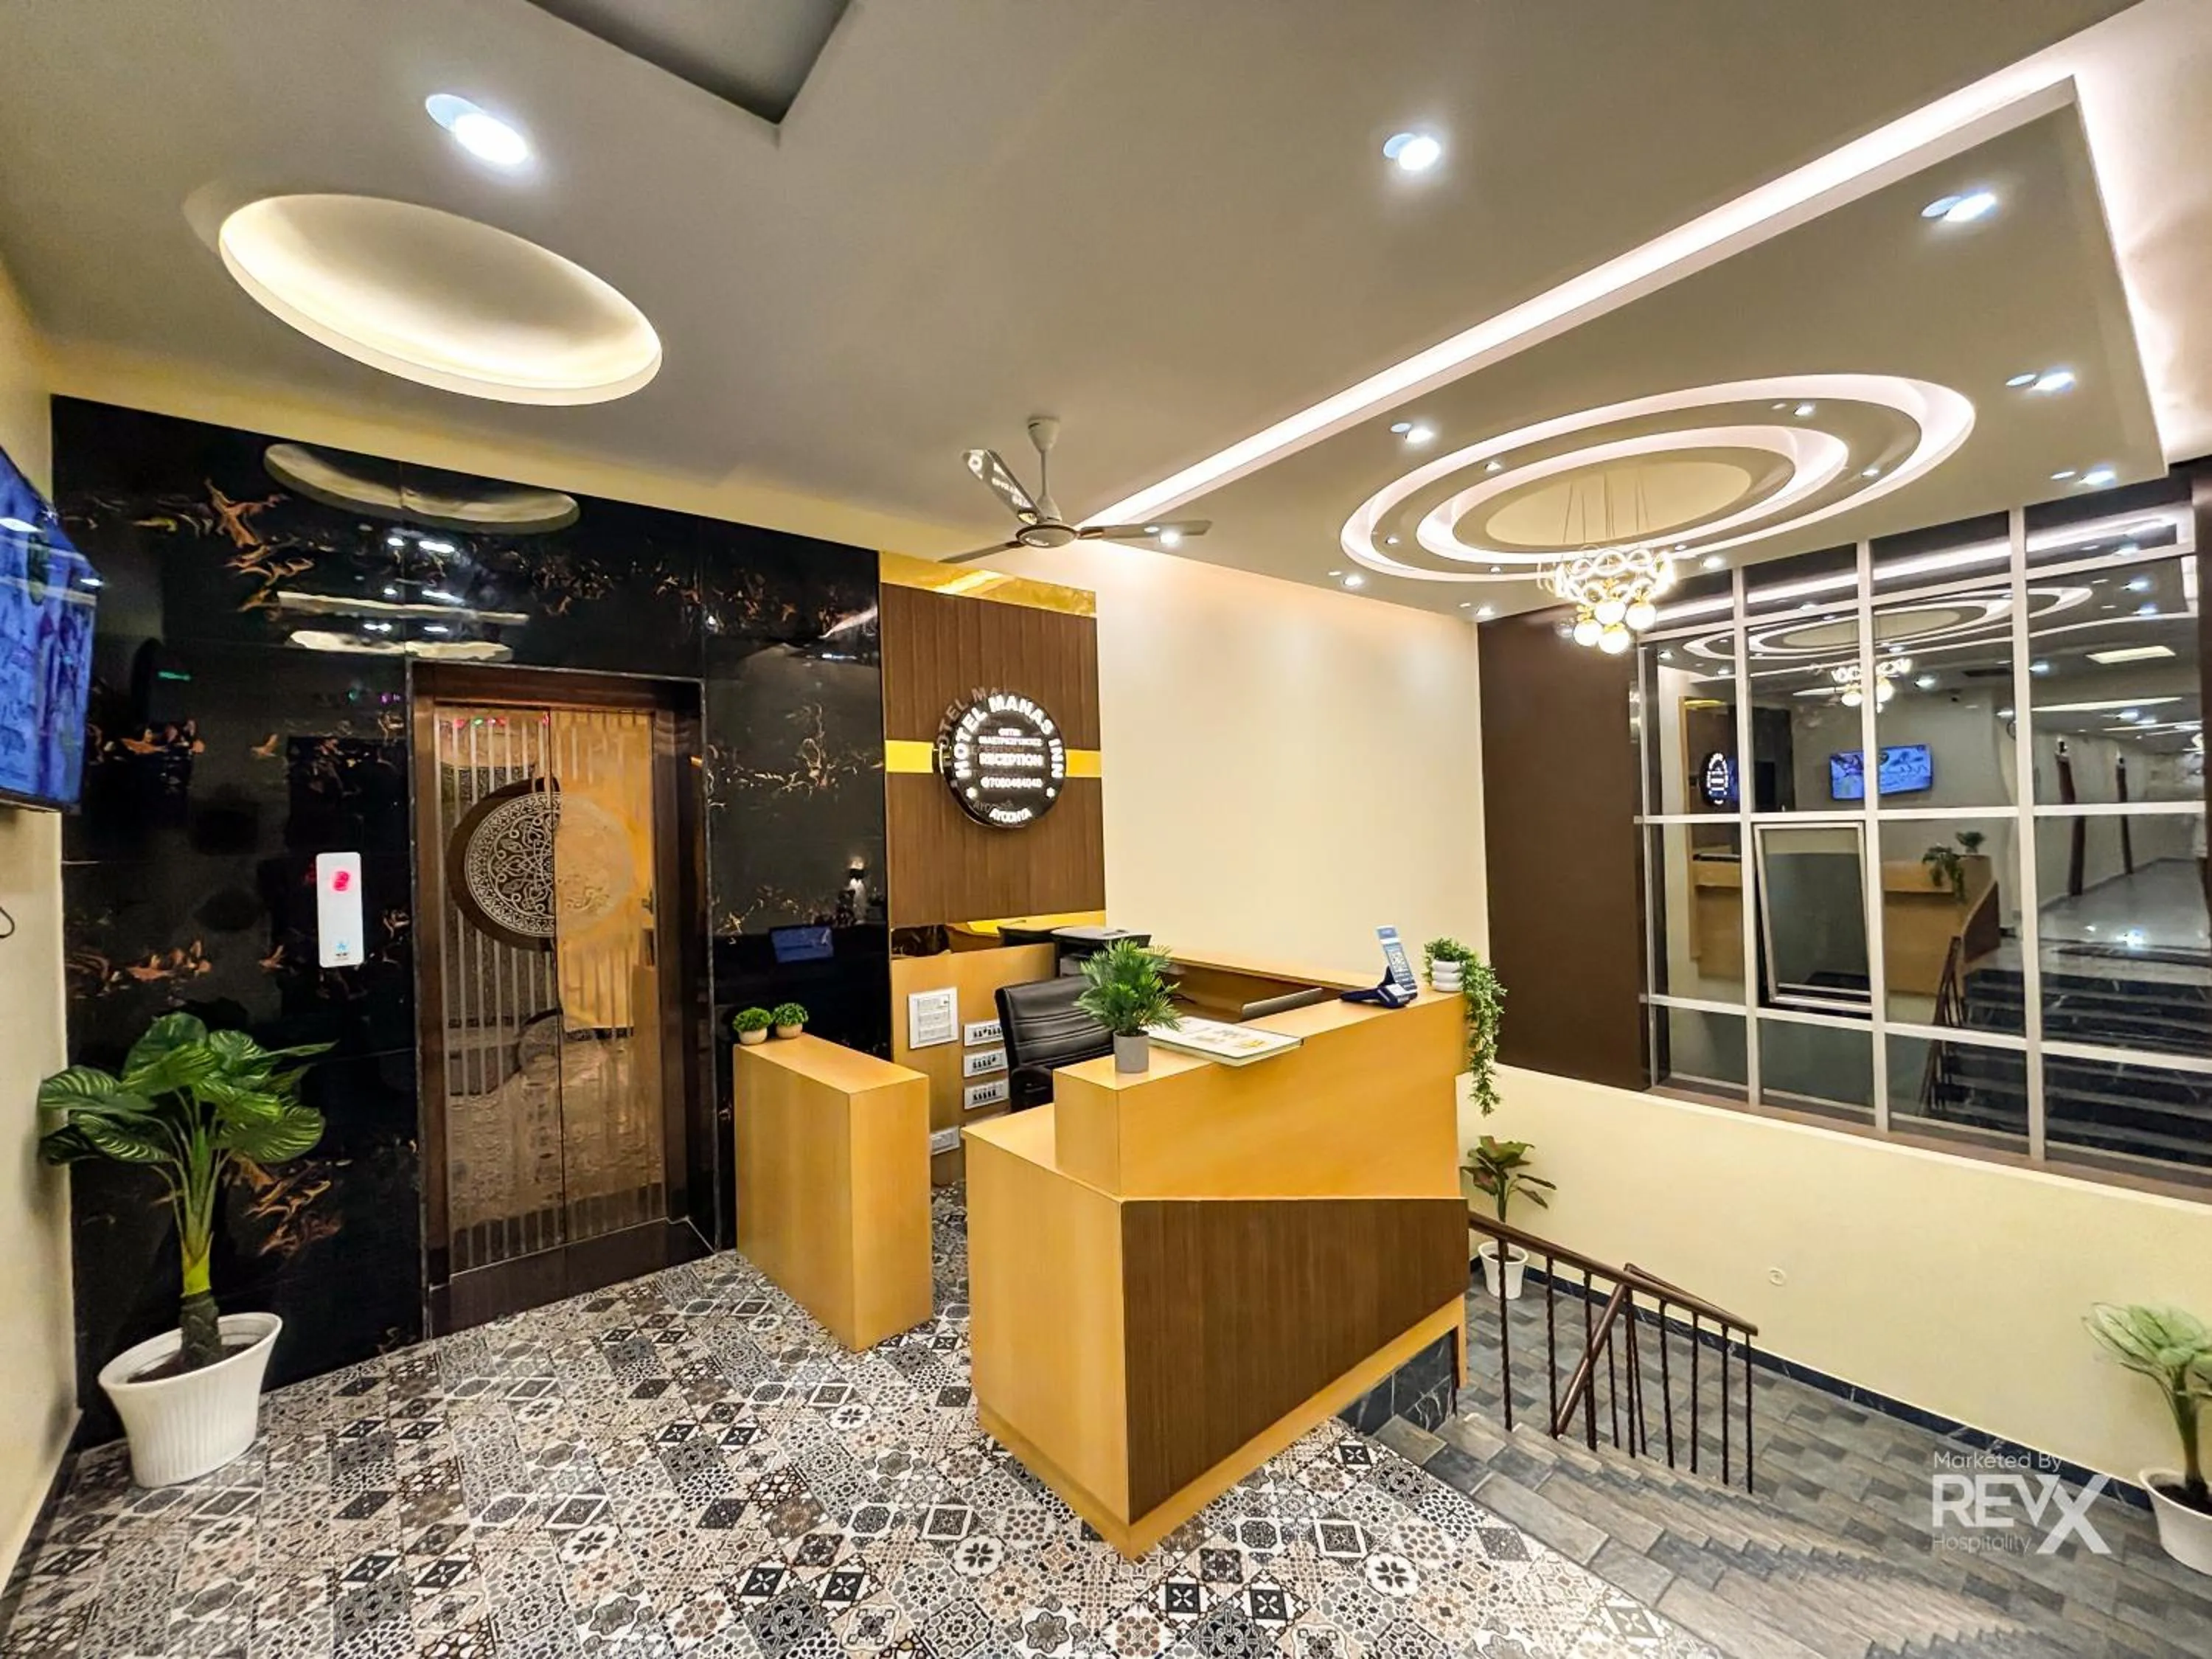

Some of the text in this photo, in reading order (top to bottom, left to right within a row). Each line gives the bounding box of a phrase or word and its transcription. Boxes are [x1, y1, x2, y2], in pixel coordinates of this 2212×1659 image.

[953, 695, 1064, 779] HOTEL MANAS INN
[978, 753, 1043, 767] RECEPTION
